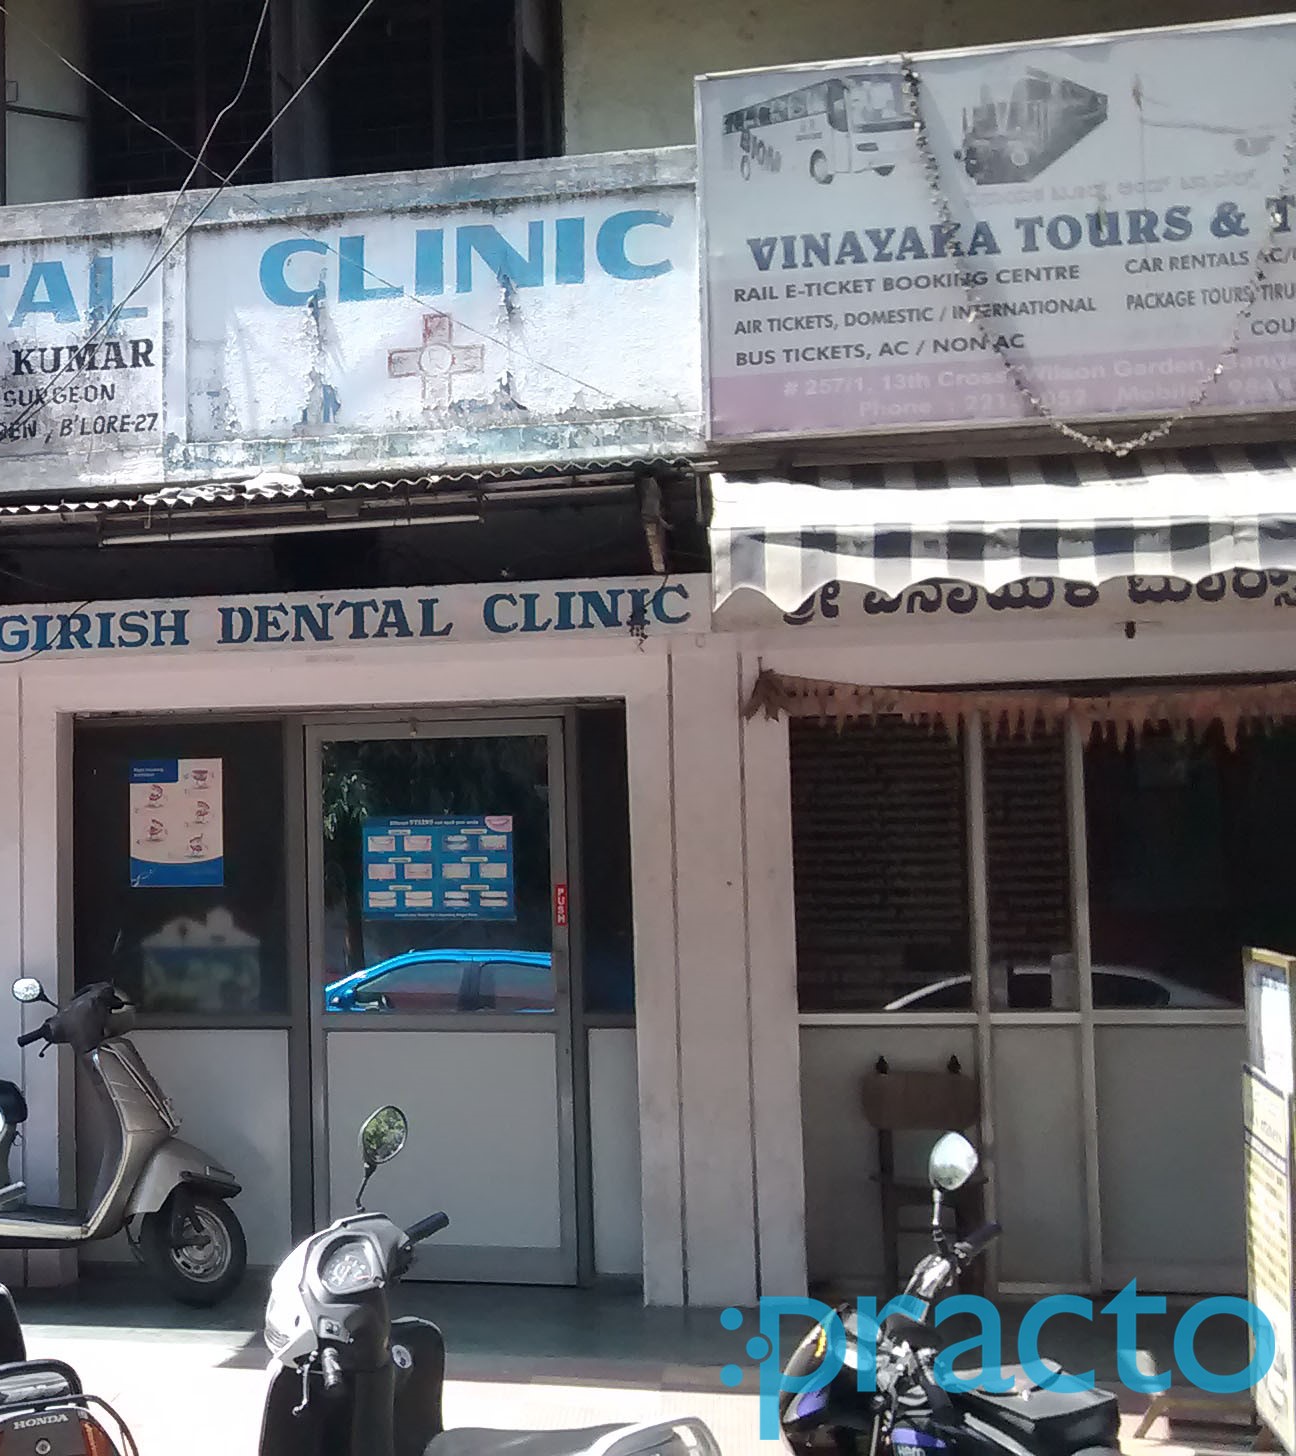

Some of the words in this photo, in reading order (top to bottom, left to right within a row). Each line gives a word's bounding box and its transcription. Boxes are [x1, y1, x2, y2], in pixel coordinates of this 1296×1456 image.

[746, 220, 1002, 271] VINAYAKA
[1015, 205, 1193, 251] TOURS
[1210, 202, 1250, 238] &
[259, 209, 674, 307] CLINIC
[1125, 257, 1164, 274] CAR
[1168, 250, 1250, 271] RENTALS
[734, 286, 778, 302] RAIL
[785, 278, 876, 299] E-TICKET
[882, 271, 989, 292] BOOKING
[995, 265, 1080, 285] CENTRE
[1126, 290, 1195, 310] PACKAGE
[734, 320, 762, 335] AIR
[844, 307, 934, 328] DOMESTIC
[952, 296, 1097, 321] INTERNATIONAL
[12, 338, 155, 376] KUMAR
[736, 350, 776, 367] BUS
[878, 341, 909, 357] AC
[4, 383, 116, 407] SURGEON
[217, 597, 454, 646] DENTAL
[483, 583, 692, 634] CLINIC
[556, 887, 566, 923] PUSH
[13, 1413, 70, 1430] HONDA
